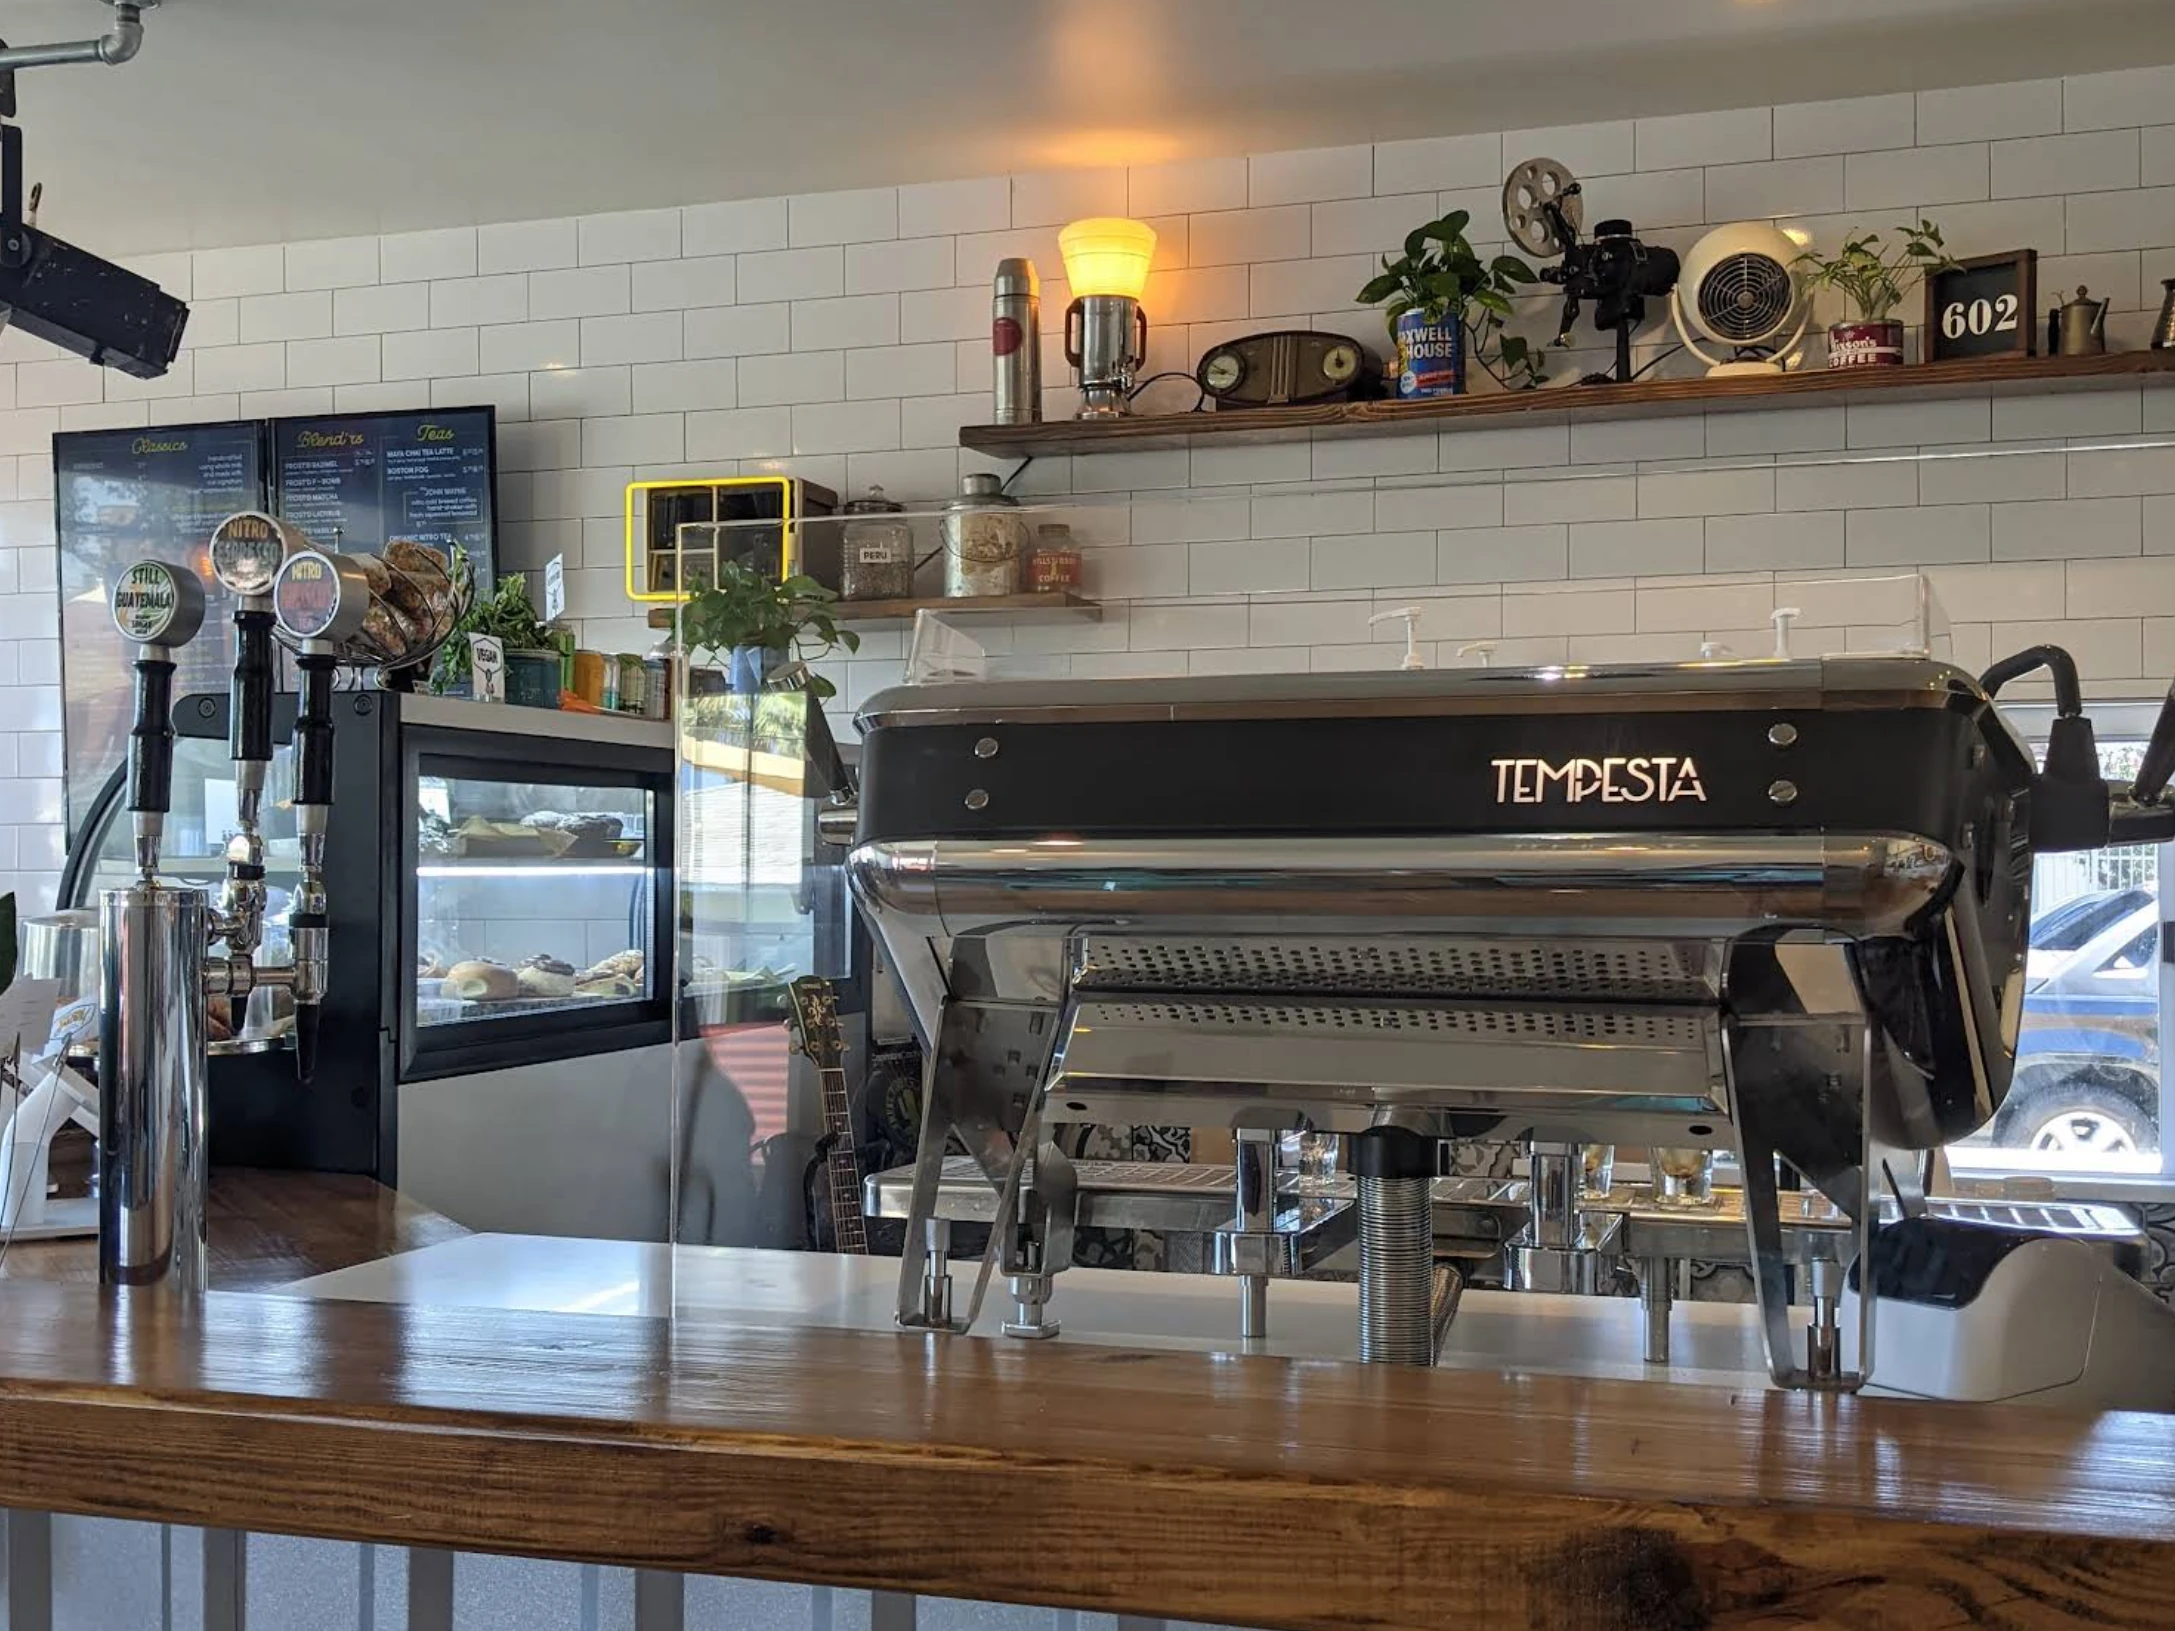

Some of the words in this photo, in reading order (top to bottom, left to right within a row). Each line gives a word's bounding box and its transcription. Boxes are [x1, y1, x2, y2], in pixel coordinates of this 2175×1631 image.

[1942, 294, 2019, 339] 602
[1398, 327, 1452, 344] AXWELL
[1406, 343, 1452, 359] HOUSE
[1829, 353, 1877, 368] COFFEE
[417, 424, 455, 441] Teas
[132, 438, 188, 454] Classics
[422, 448, 434, 456] TEA
[434, 447, 454, 455] LATTE
[387, 466, 414, 475] BOSTON
[414, 465, 429, 473] FOG
[228, 520, 269, 538] NITRO
[216, 540, 279, 565] ESPRESSO
[863, 551, 887, 561] PERU
[131, 567, 160, 584] STILL
[291, 561, 323, 580] NITRO
[116, 591, 171, 608] GUATEMALA
[476, 647, 498, 664] VEGAN
[1491, 757, 1708, 803] TEMPESTA
